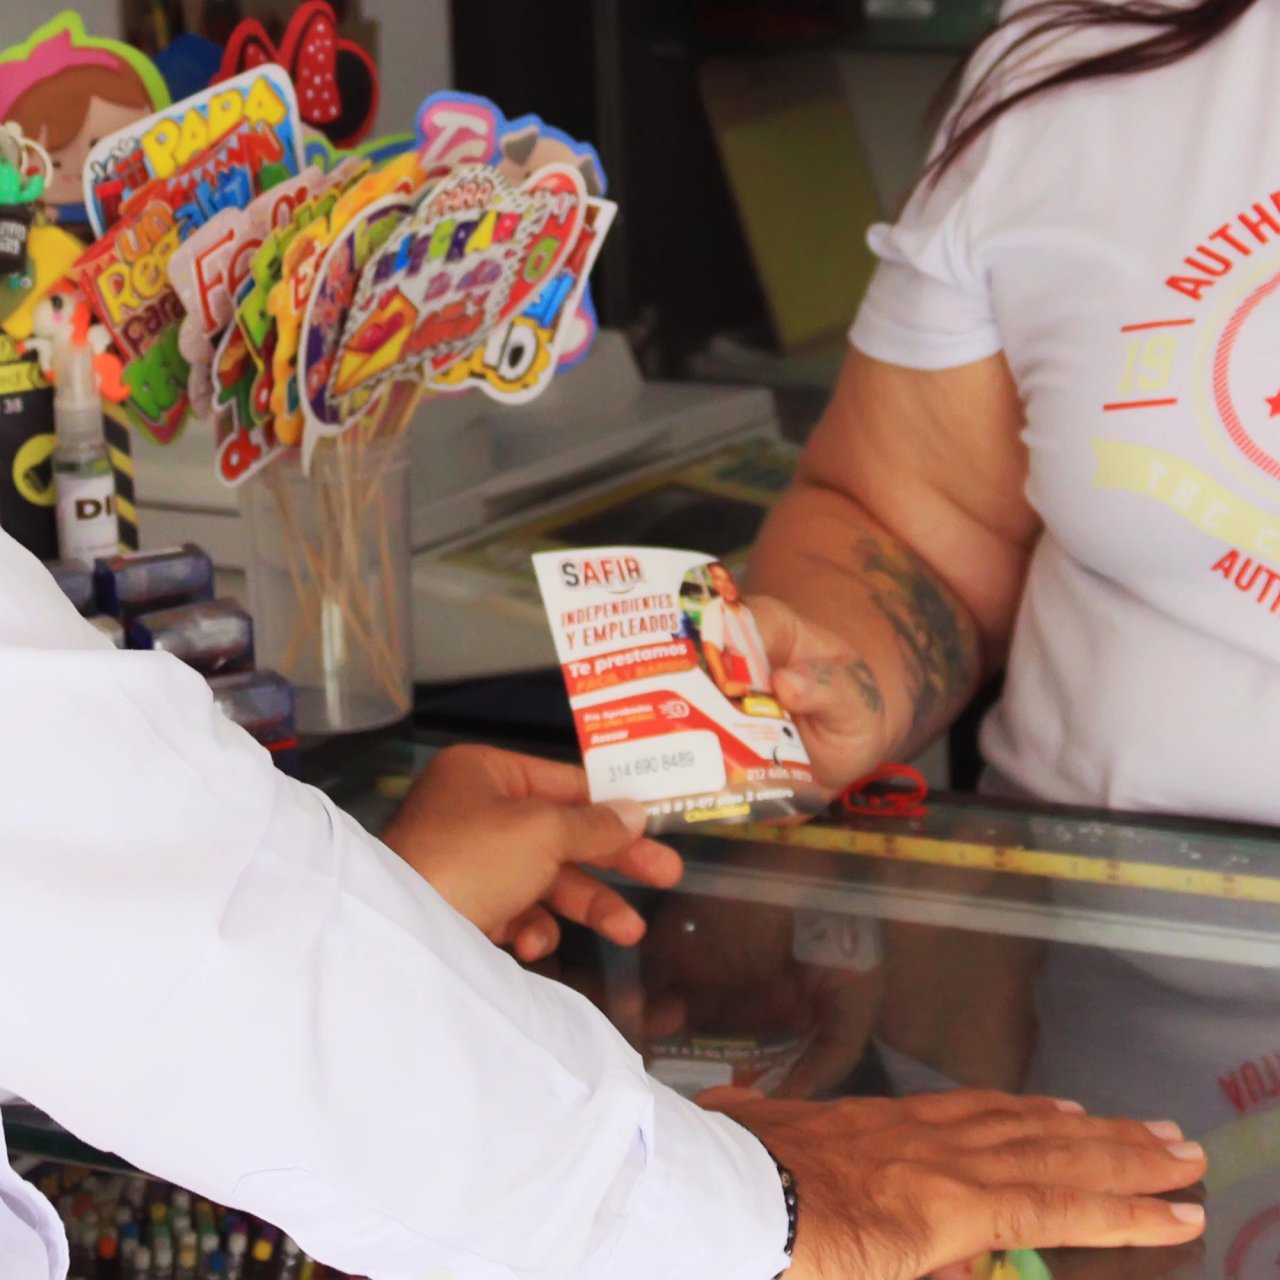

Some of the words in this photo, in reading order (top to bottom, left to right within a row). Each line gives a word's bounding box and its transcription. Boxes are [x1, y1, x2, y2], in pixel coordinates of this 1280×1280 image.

[1117, 335, 1178, 394] 19
[561, 558, 642, 587] SAFIR
[561, 593, 674, 628] INDEPENDIENTES
[583, 612, 679, 647] EMPLEADOS
